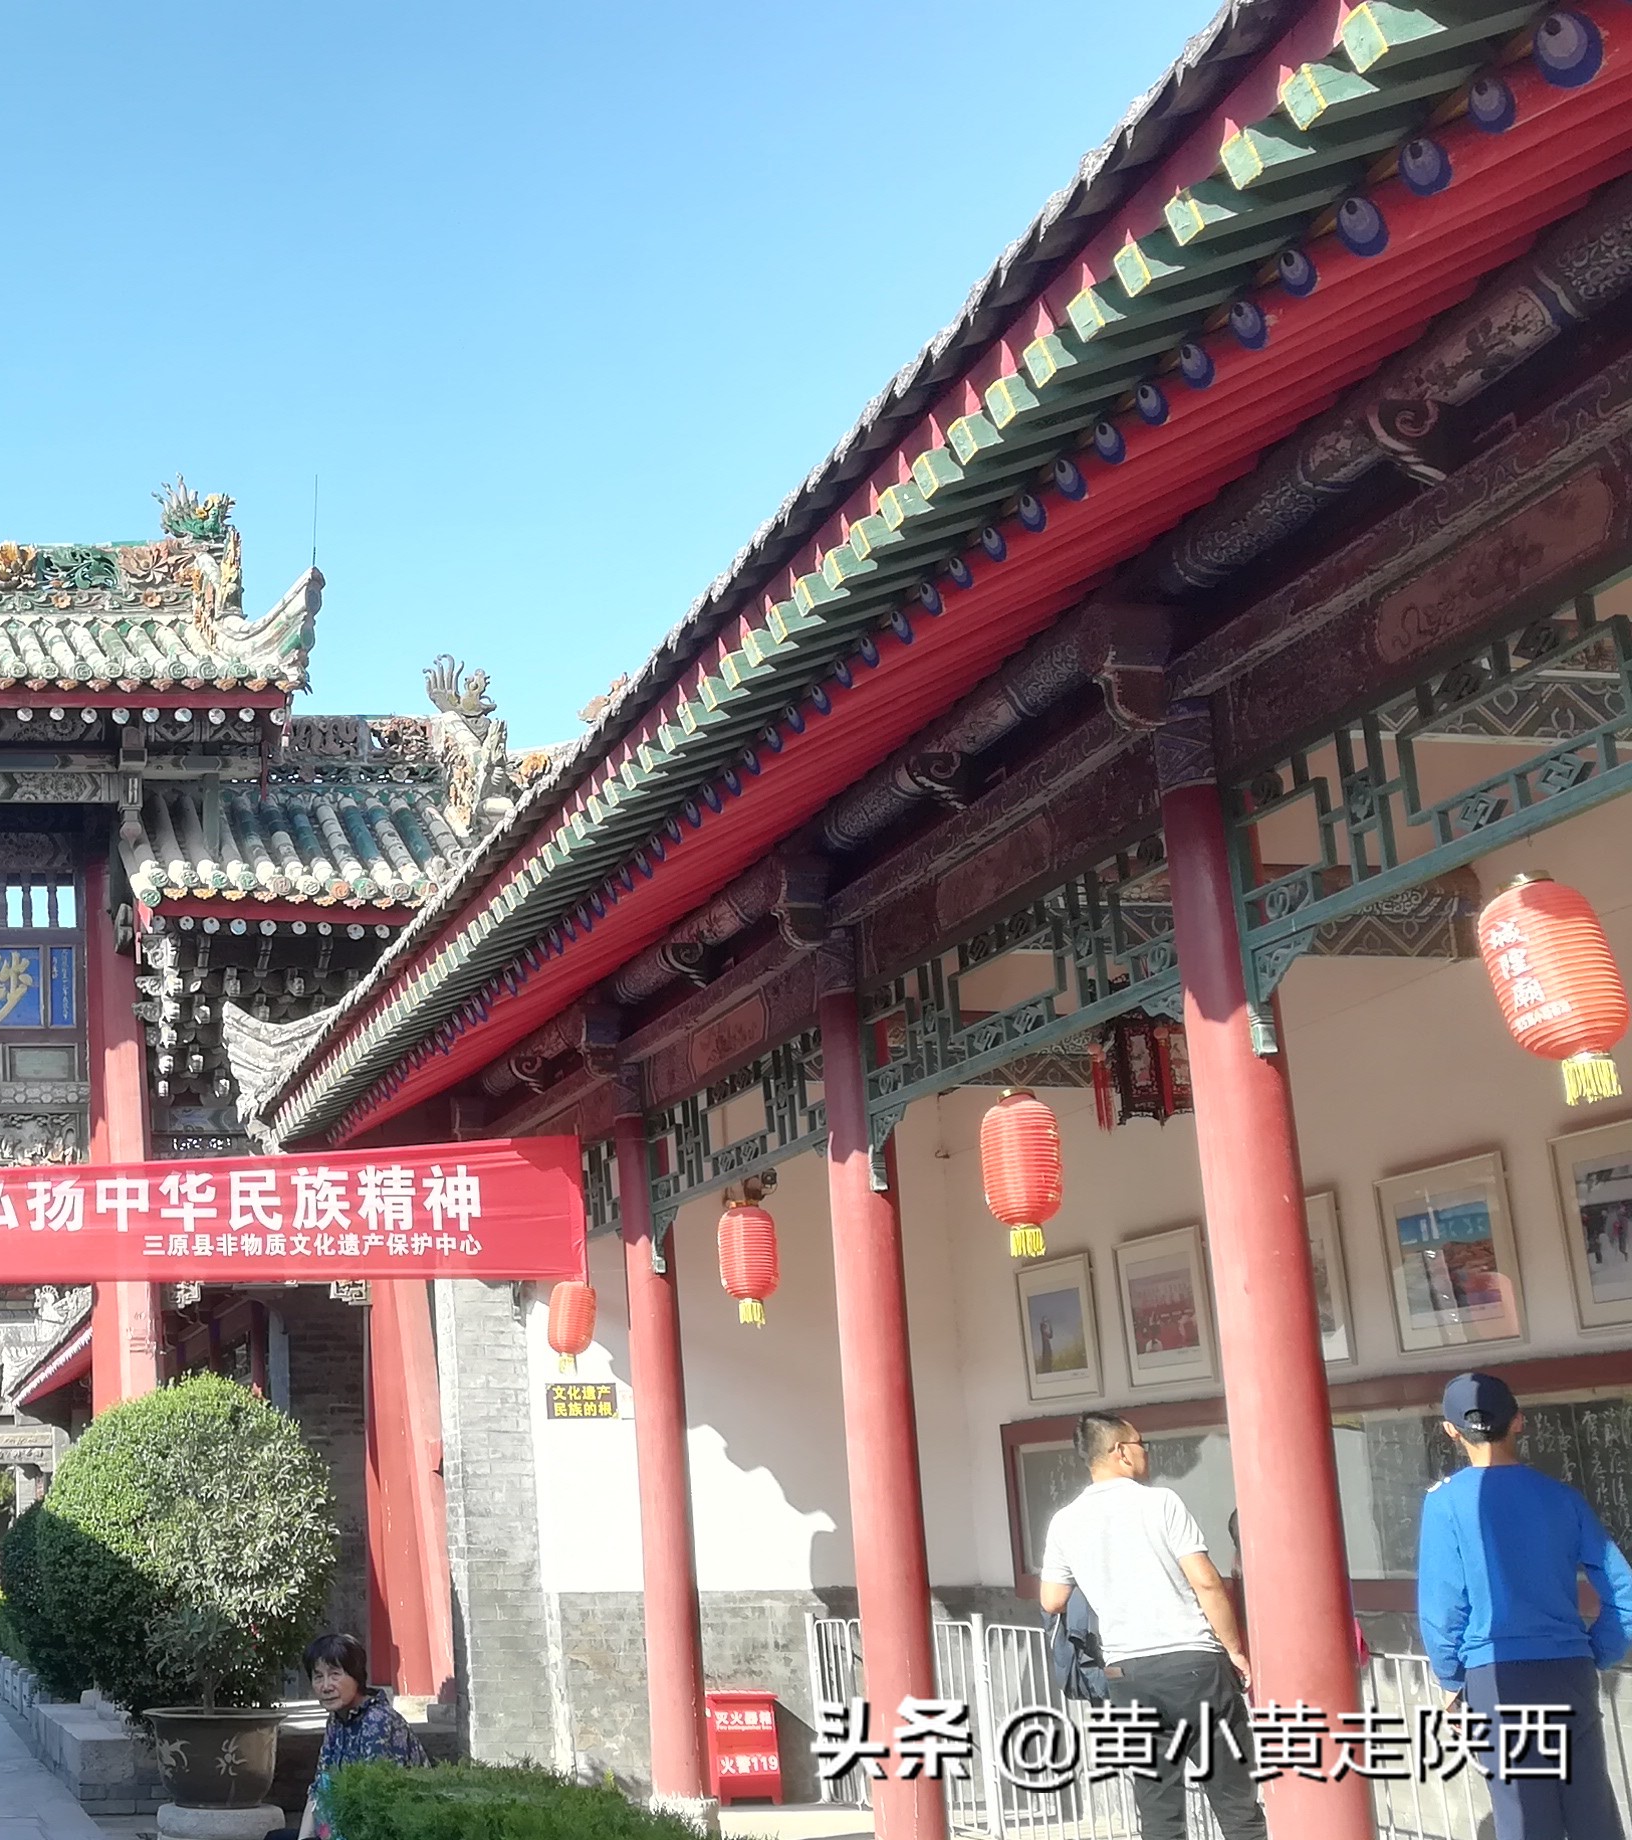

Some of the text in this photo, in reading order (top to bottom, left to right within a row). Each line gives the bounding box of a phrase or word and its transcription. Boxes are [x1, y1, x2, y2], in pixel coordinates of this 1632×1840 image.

[142, 1233, 483, 1257] 三原县非物质文化遗产保护中心
[552, 1385, 611, 1400] 文化遗产
[553, 1401, 612, 1416] 民族的根
[720, 1755, 778, 1775] 火警119
